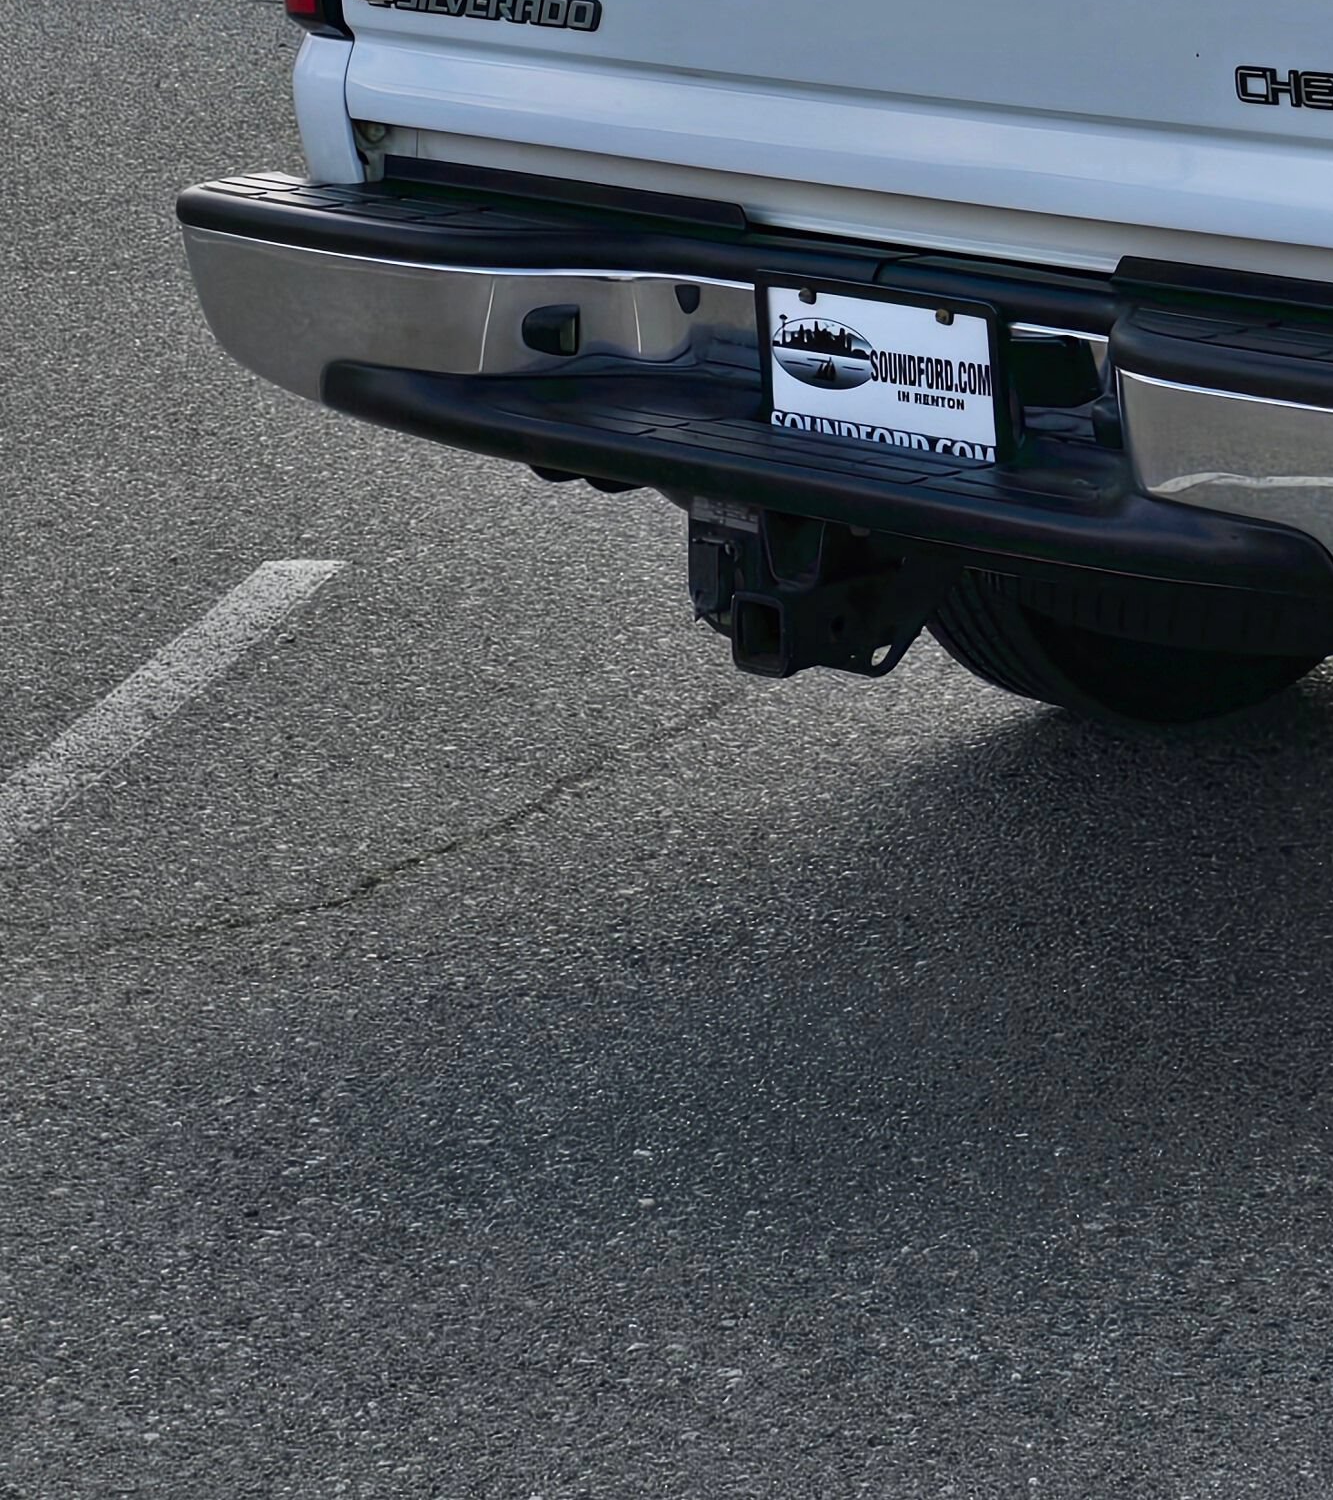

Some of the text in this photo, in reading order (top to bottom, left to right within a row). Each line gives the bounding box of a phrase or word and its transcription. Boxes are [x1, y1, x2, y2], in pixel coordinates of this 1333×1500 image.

[869, 349, 992, 397] SOUNDFORD.COM
[897, 390, 965, 411] IN RENTON
